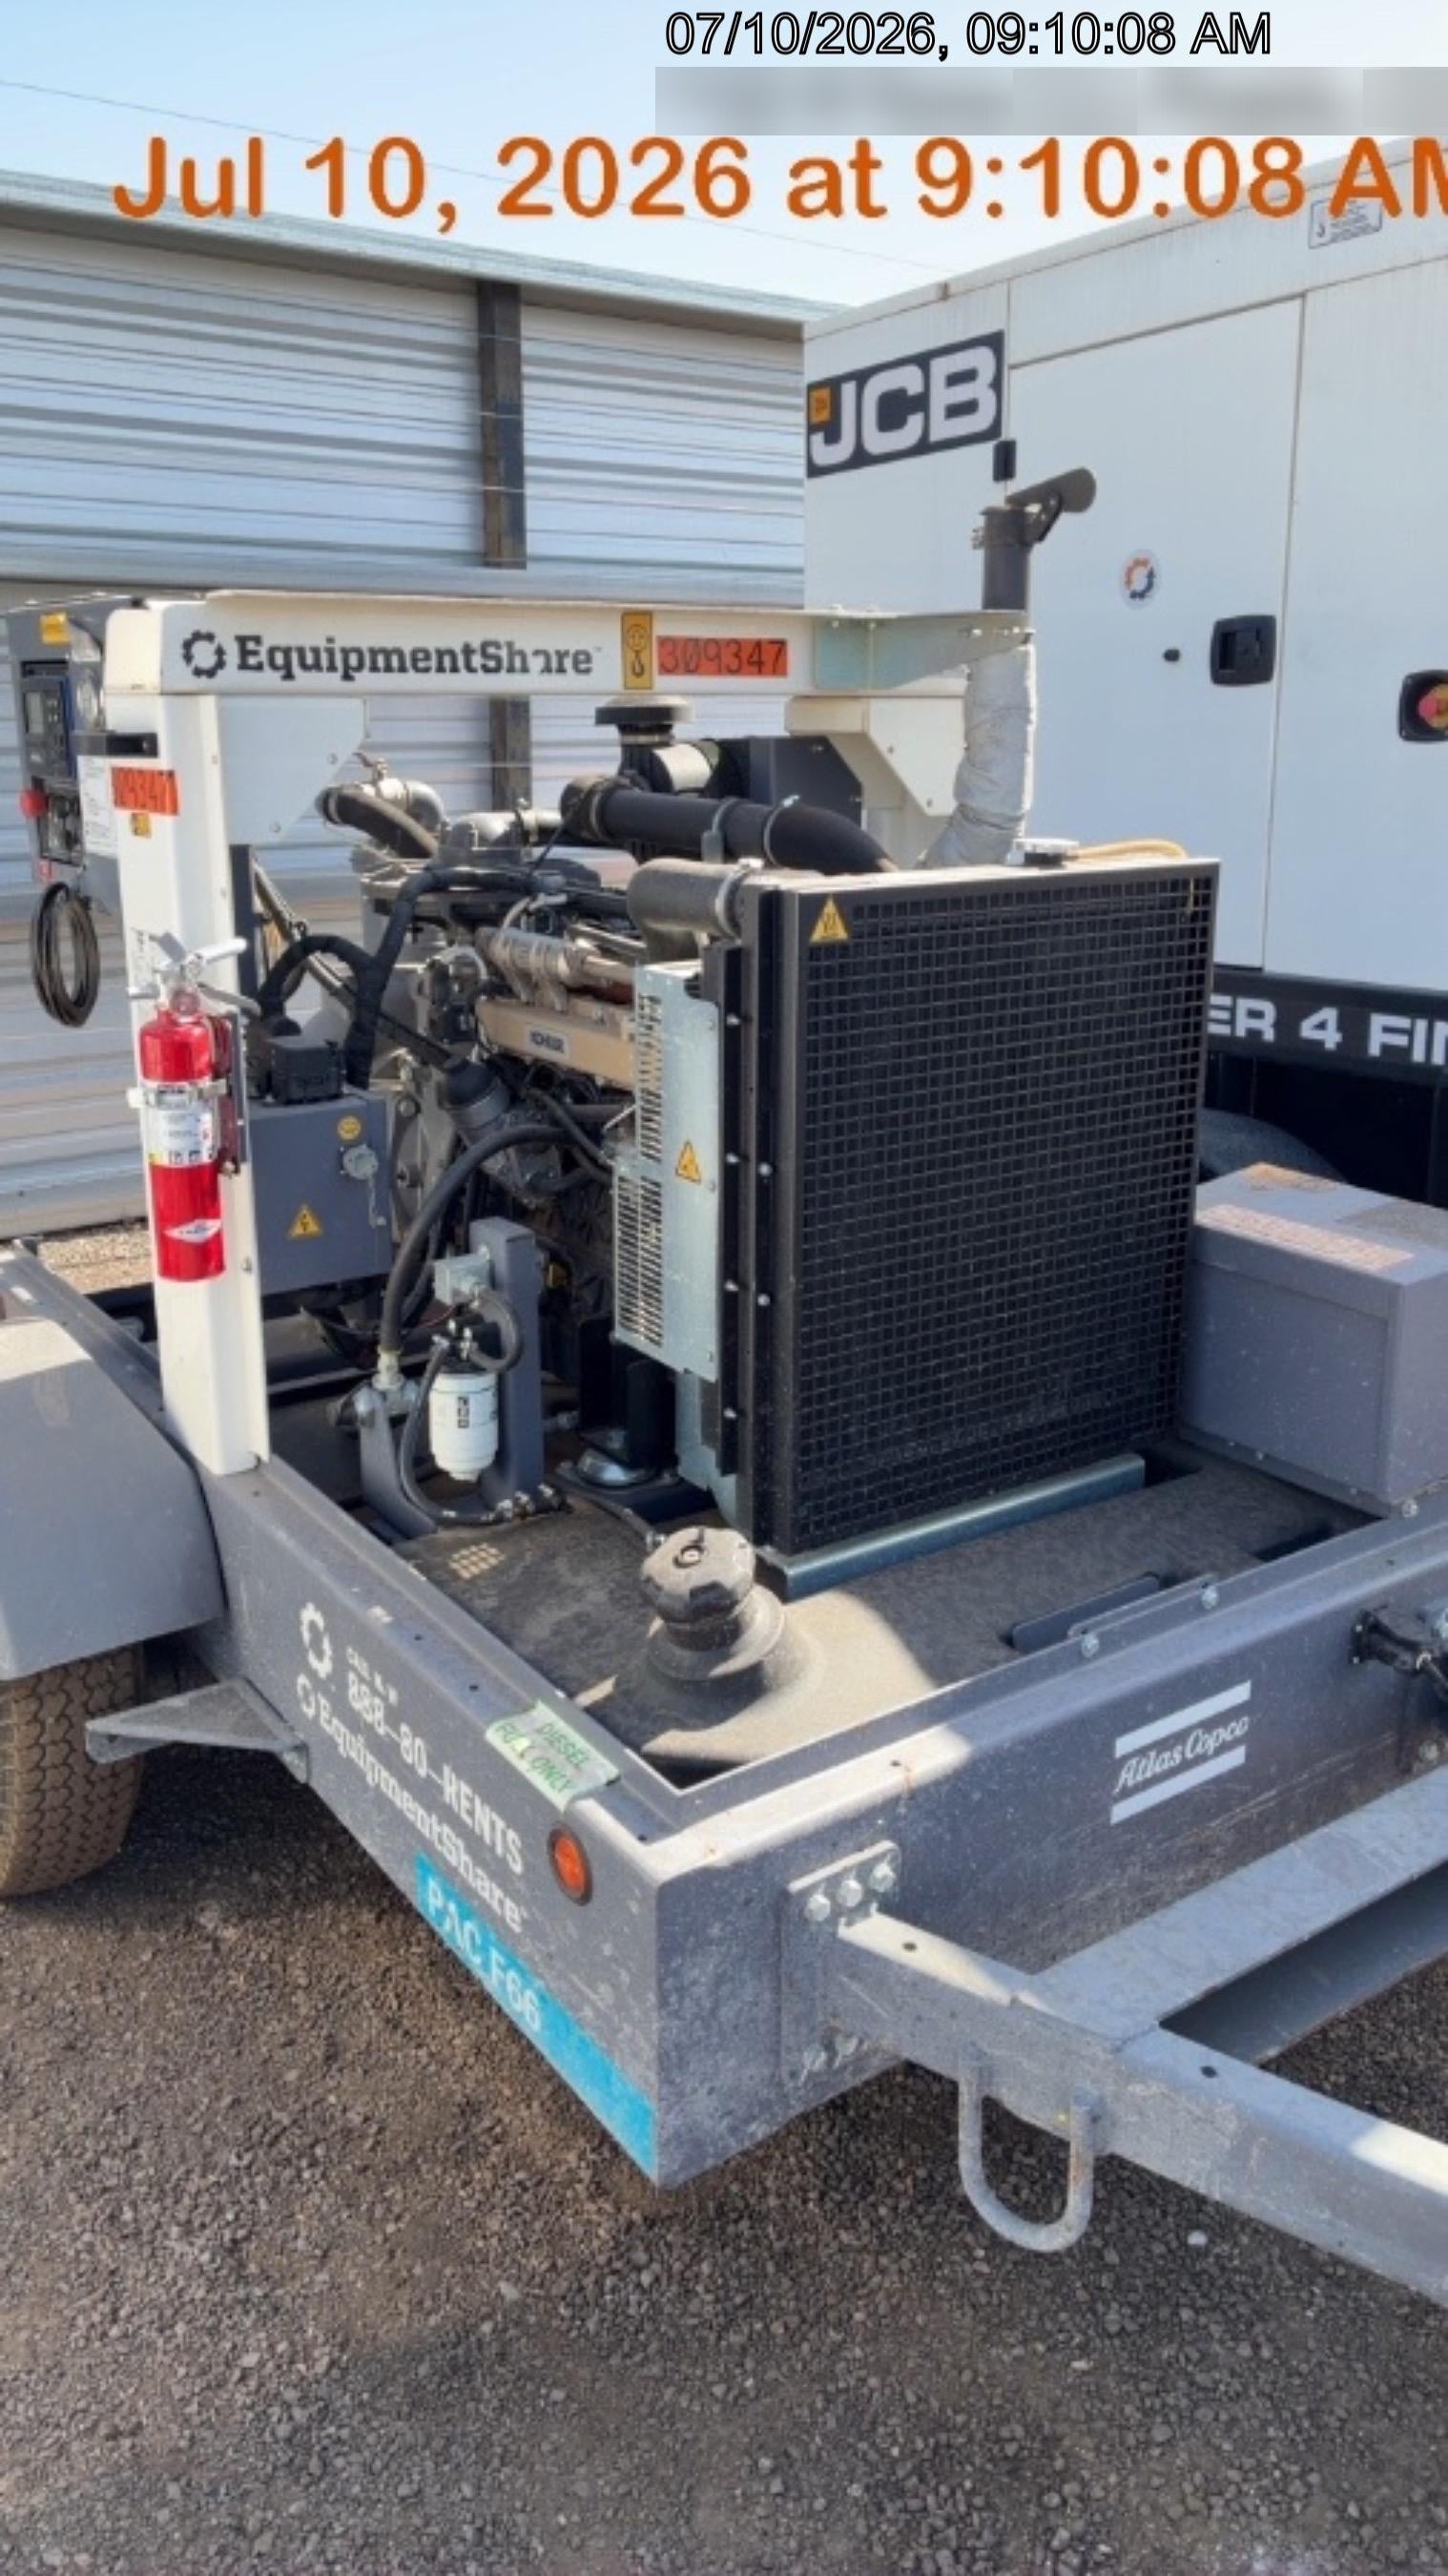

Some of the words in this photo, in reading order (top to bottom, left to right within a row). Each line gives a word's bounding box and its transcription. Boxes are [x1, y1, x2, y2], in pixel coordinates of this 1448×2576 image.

[810, 344, 998, 467] JCB
[658, 637, 786, 676] 309347
[1299, 1006, 1343, 1050] 4
[1112, 1744, 1184, 1797] Atlas
[1184, 1716, 1250, 1760] Copco
